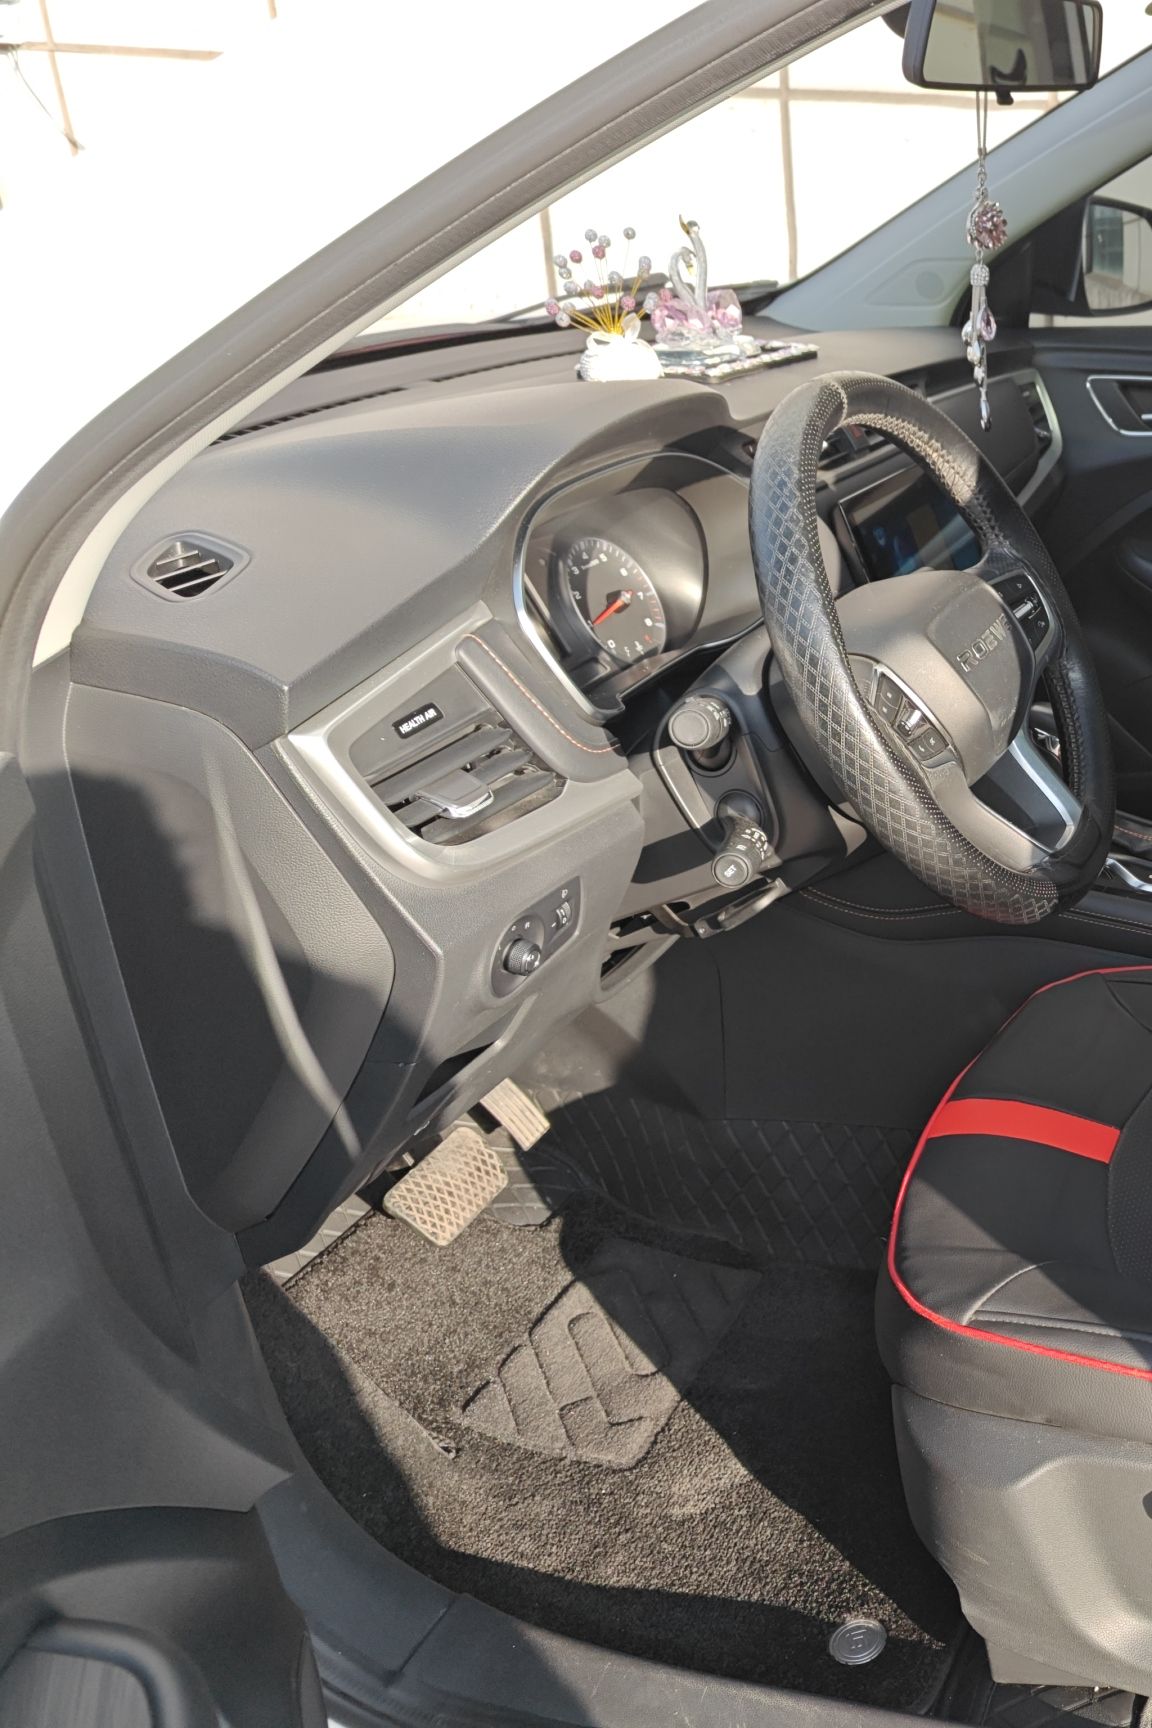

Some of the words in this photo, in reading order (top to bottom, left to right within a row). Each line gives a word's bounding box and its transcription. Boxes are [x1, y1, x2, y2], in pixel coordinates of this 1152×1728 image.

[398, 713, 426, 735] HEALTH
[424, 708, 438, 721] AIR
[724, 864, 737, 878] SET
